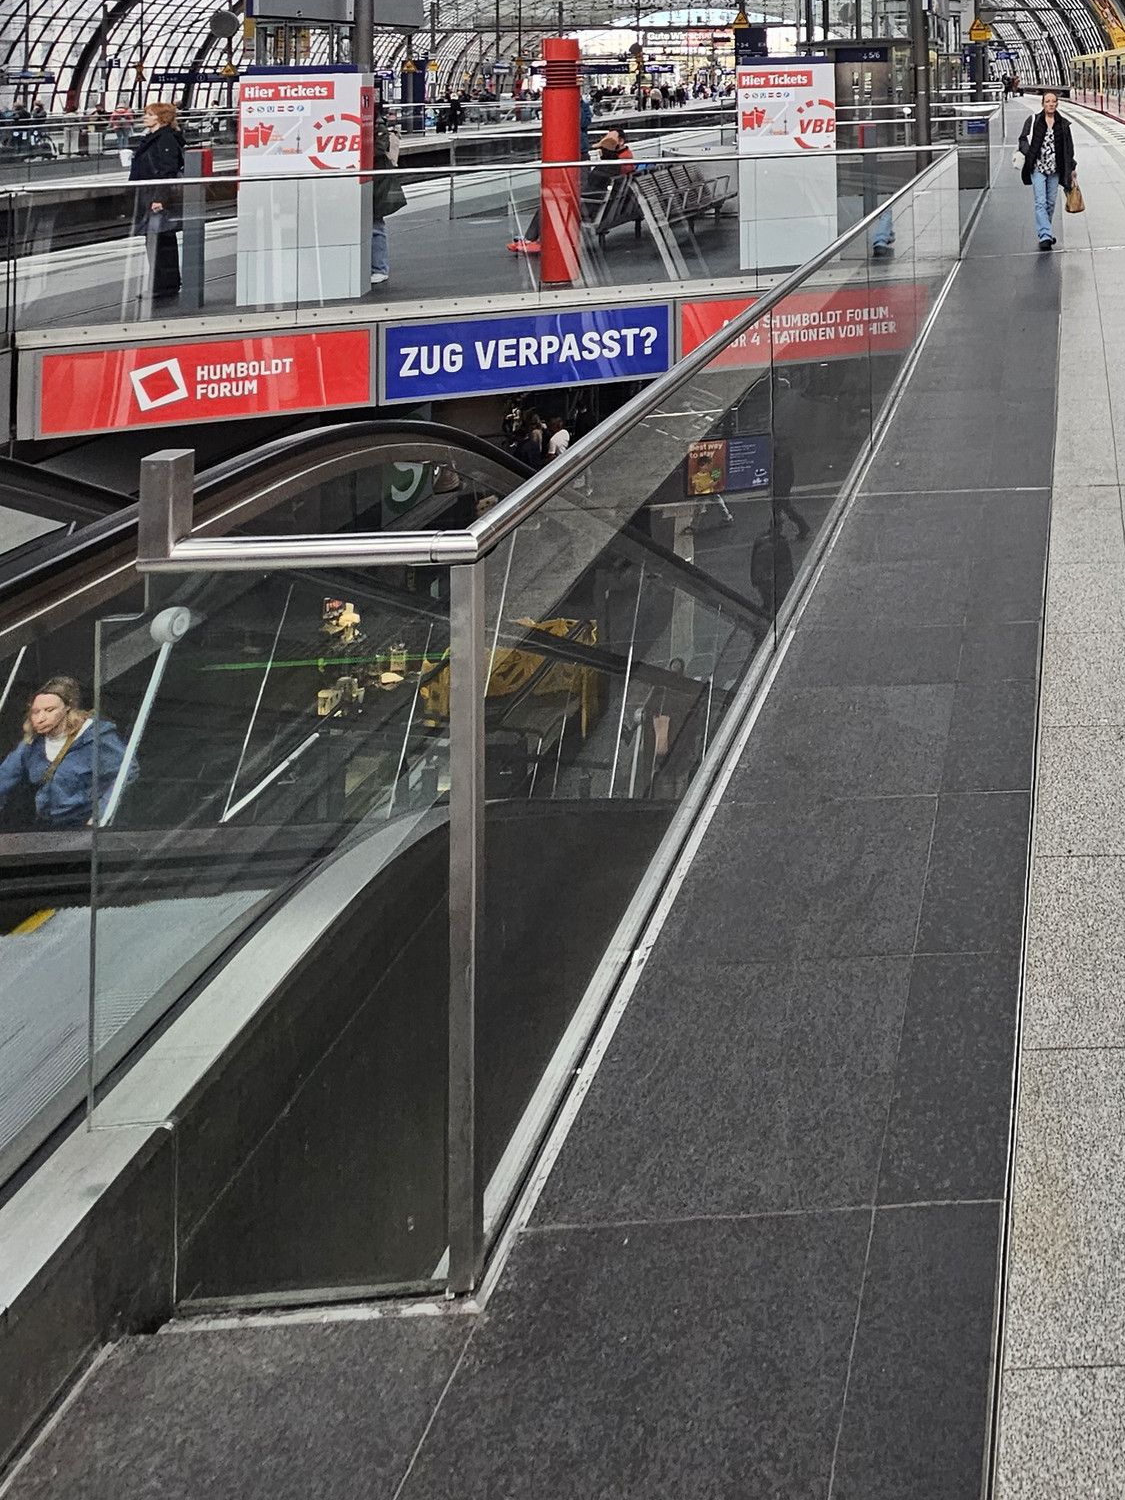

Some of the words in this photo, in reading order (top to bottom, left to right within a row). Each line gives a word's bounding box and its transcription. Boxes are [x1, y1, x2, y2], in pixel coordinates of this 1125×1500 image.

[741, 75, 765, 86] Hier
[768, 74, 808, 85] Tickets
[244, 86, 274, 98] Hier
[278, 85, 328, 97] Tickets
[771, 310, 842, 328] HUMBOLDT
[751, 332, 760, 346] 4
[768, 326, 835, 344] TATIONEN
[839, 324, 863, 338] VON
[399, 342, 463, 377] ZUG
[475, 326, 659, 370] VERPASST?
[196, 357, 294, 382] HUMBOLDT
[196, 379, 258, 400] FORUM
